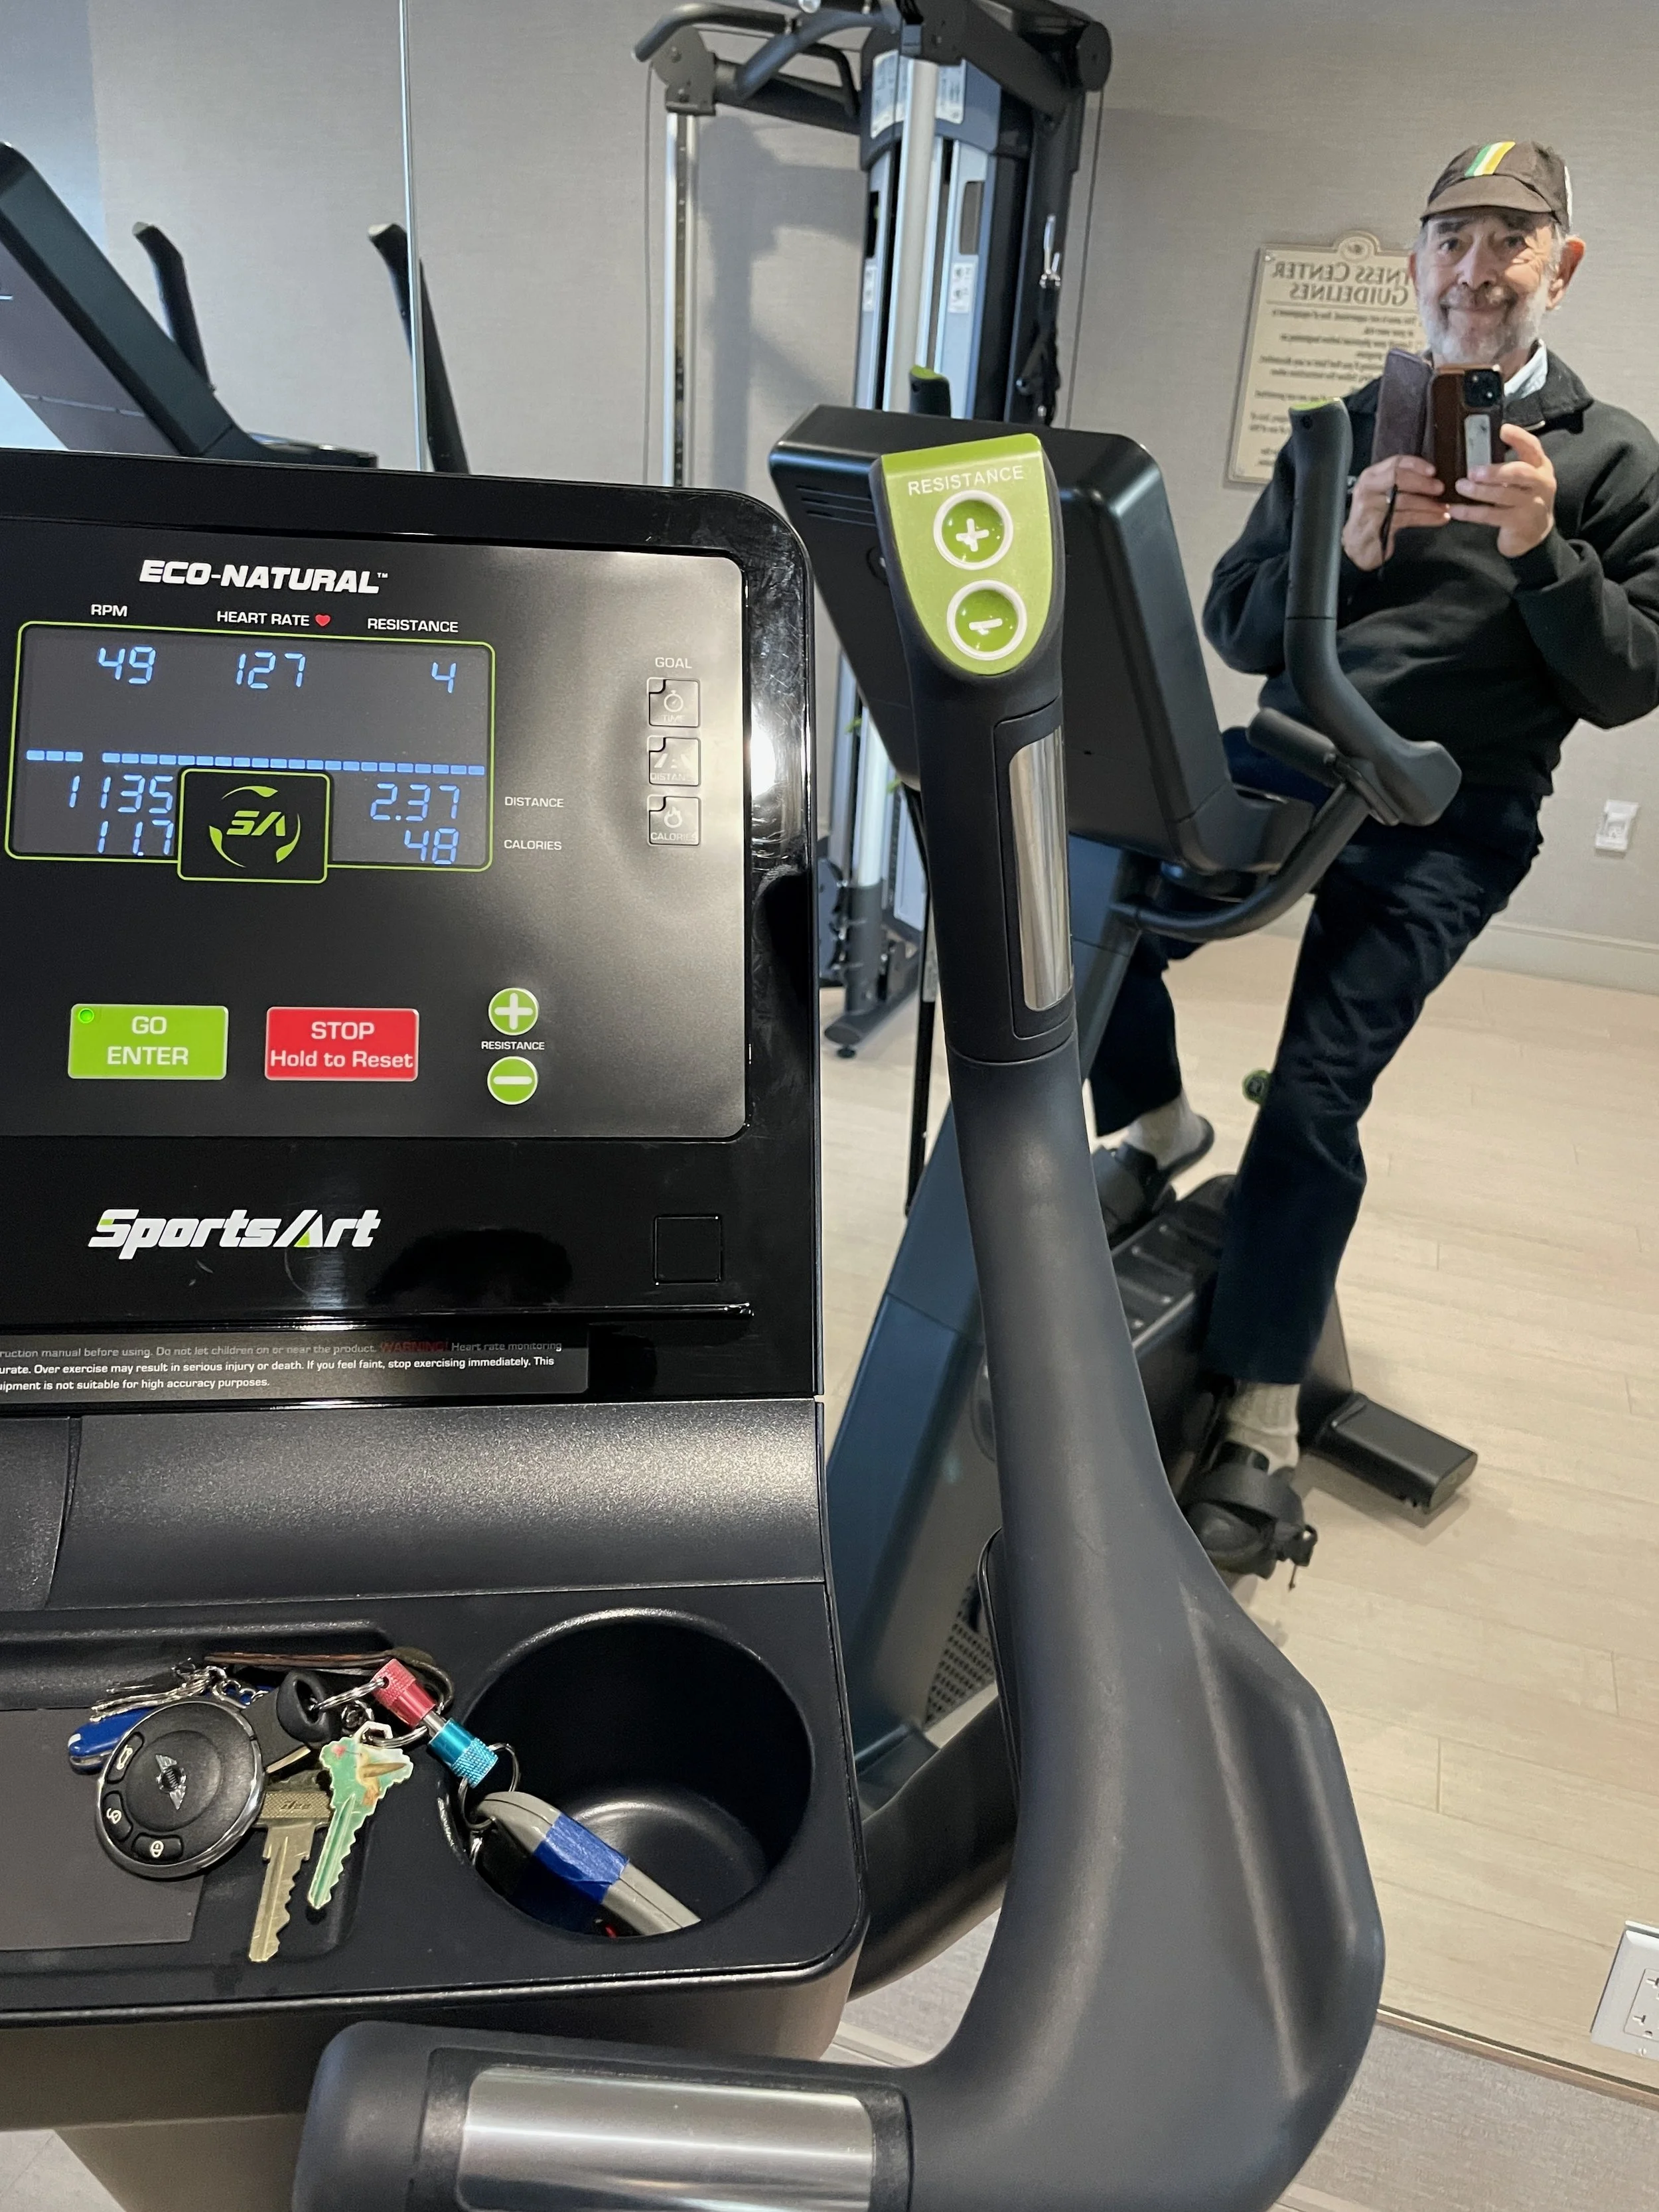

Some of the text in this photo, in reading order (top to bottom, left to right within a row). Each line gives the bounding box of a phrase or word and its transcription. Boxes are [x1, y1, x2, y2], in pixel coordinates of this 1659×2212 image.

[908, 465, 1024, 496] RESISTANCE
[91, 604, 127, 617] RPM
[217, 611, 309, 627] HEART RATE
[368, 618, 459, 633] RESISTANCE
[98, 646, 156, 684] 49
[236, 651, 306, 689] 127
[655, 657, 692, 669] GOAL
[431, 662, 457, 693] 4
[661, 714, 685, 723] TIME
[370, 782, 460, 822] 2.37
[504, 796, 564, 808] DISTANCE
[504, 840, 562, 851] CALORIES
[650, 832, 697, 842] CALORIES
[404, 828, 459, 865] 48
[131, 1016, 167, 1034] GO
[311, 1021, 375, 1040] STOP
[481, 1041, 545, 1051] RESISTANCE
[107, 1046, 188, 1065] ENTER
[270, 1049, 413, 1068] Hold to Reset
[88, 1209, 381, 1259] SportsArt
[42, 1348, 81, 1357] manual
[84, 1347, 119, 1357] before
[122, 1347, 153, 1359] using.
[156, 1347, 170, 1356] Do
[174, 1347, 192, 1356] not
[194, 1346, 208, 1355] let
[211, 1345, 253, 1355] children
[313, 1345, 330, 1354] the
[333, 1345, 376, 1355] product.
[452, 1342, 481, 1351] Heart
[508, 1342, 562, 1352] monitoring
[34, 1364, 60, 1374] Over
[62, 1364, 108, 1373] exercise
[111, 1365, 133, 1374] may
[136, 1363, 167, 1372] result
[171, 1363, 180, 1372] in
[183, 1362, 222, 1372] serious
[225, 1362, 254, 1372] injury
[271, 1361, 304, 1370] death.
[307, 1361, 315, 1369] If
[317, 1362, 334, 1371] you
[337, 1360, 356, 1369] feel
[359, 1359, 385, 1370] faint,
[388, 1360, 411, 1370] stop
[413, 1358, 465, 1369] exercising
[468, 1357, 531, 1368] immediately.
[534, 1356, 555, 1366] This
[44, 1380, 53, 1390] is
[56, 1381, 74, 1390] not
[77, 1380, 119, 1389] suitable
[122, 1379, 139, 1389] for
[141, 1378, 164, 1390] high
[167, 1379, 216, 1389] accuracy
[218, 1378, 270, 1390] purposes.
